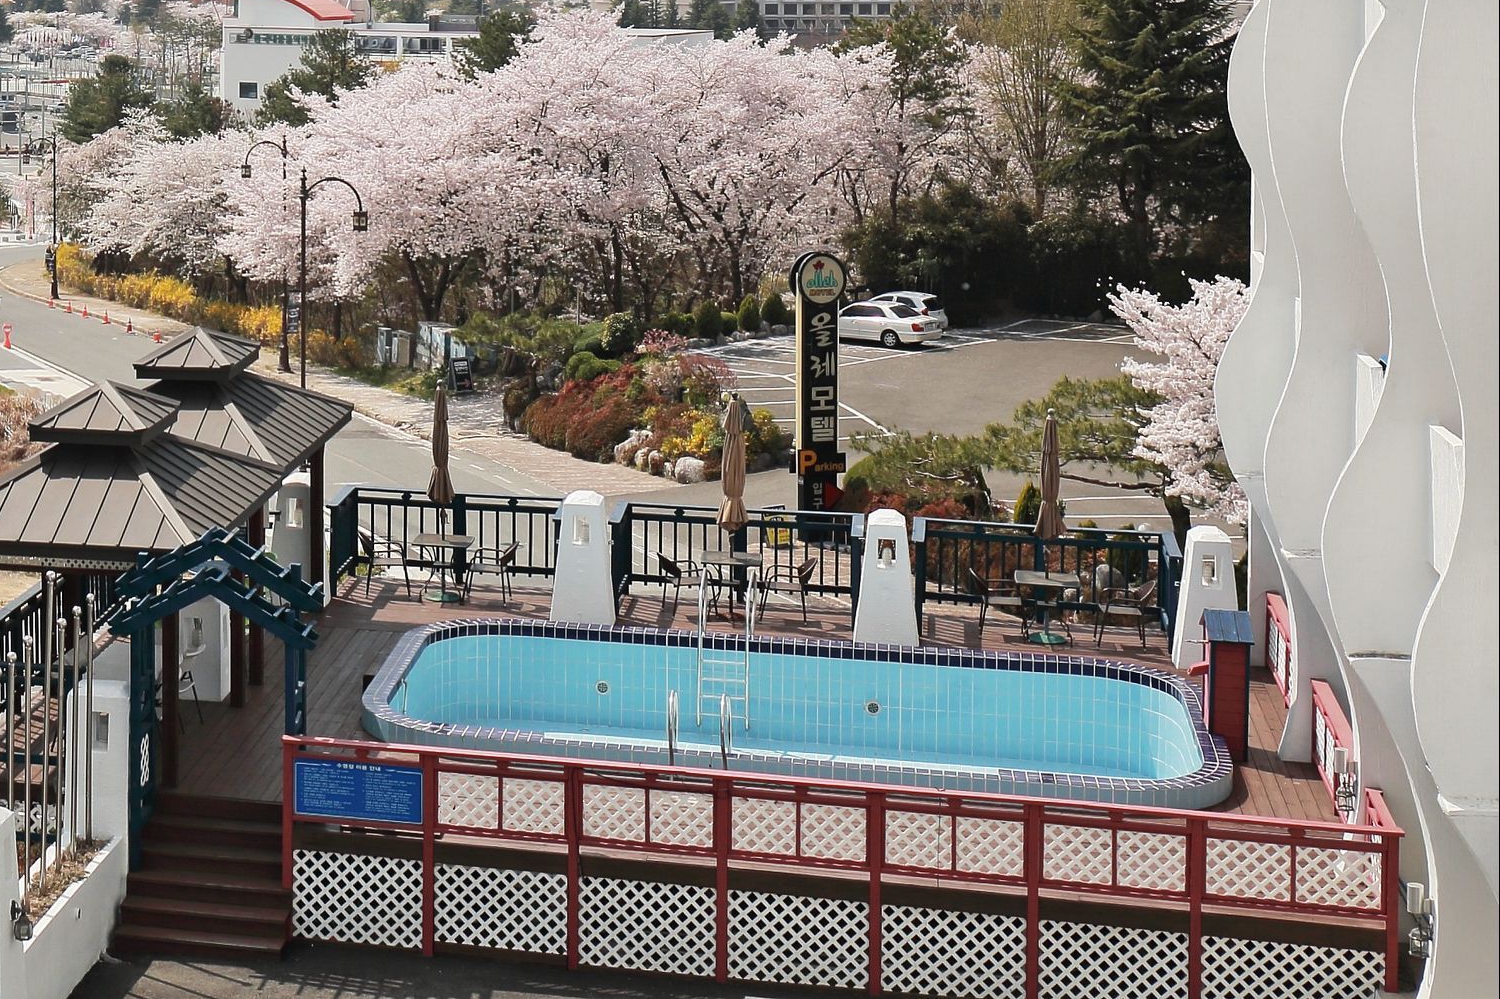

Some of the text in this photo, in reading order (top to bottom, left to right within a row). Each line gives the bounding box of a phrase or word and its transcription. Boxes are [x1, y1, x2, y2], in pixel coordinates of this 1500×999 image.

[806, 269, 838, 288] olleh
[810, 312, 835, 442] 올레 모텔
[799, 450, 844, 475] Parking
[812, 482, 823, 510] 입구
